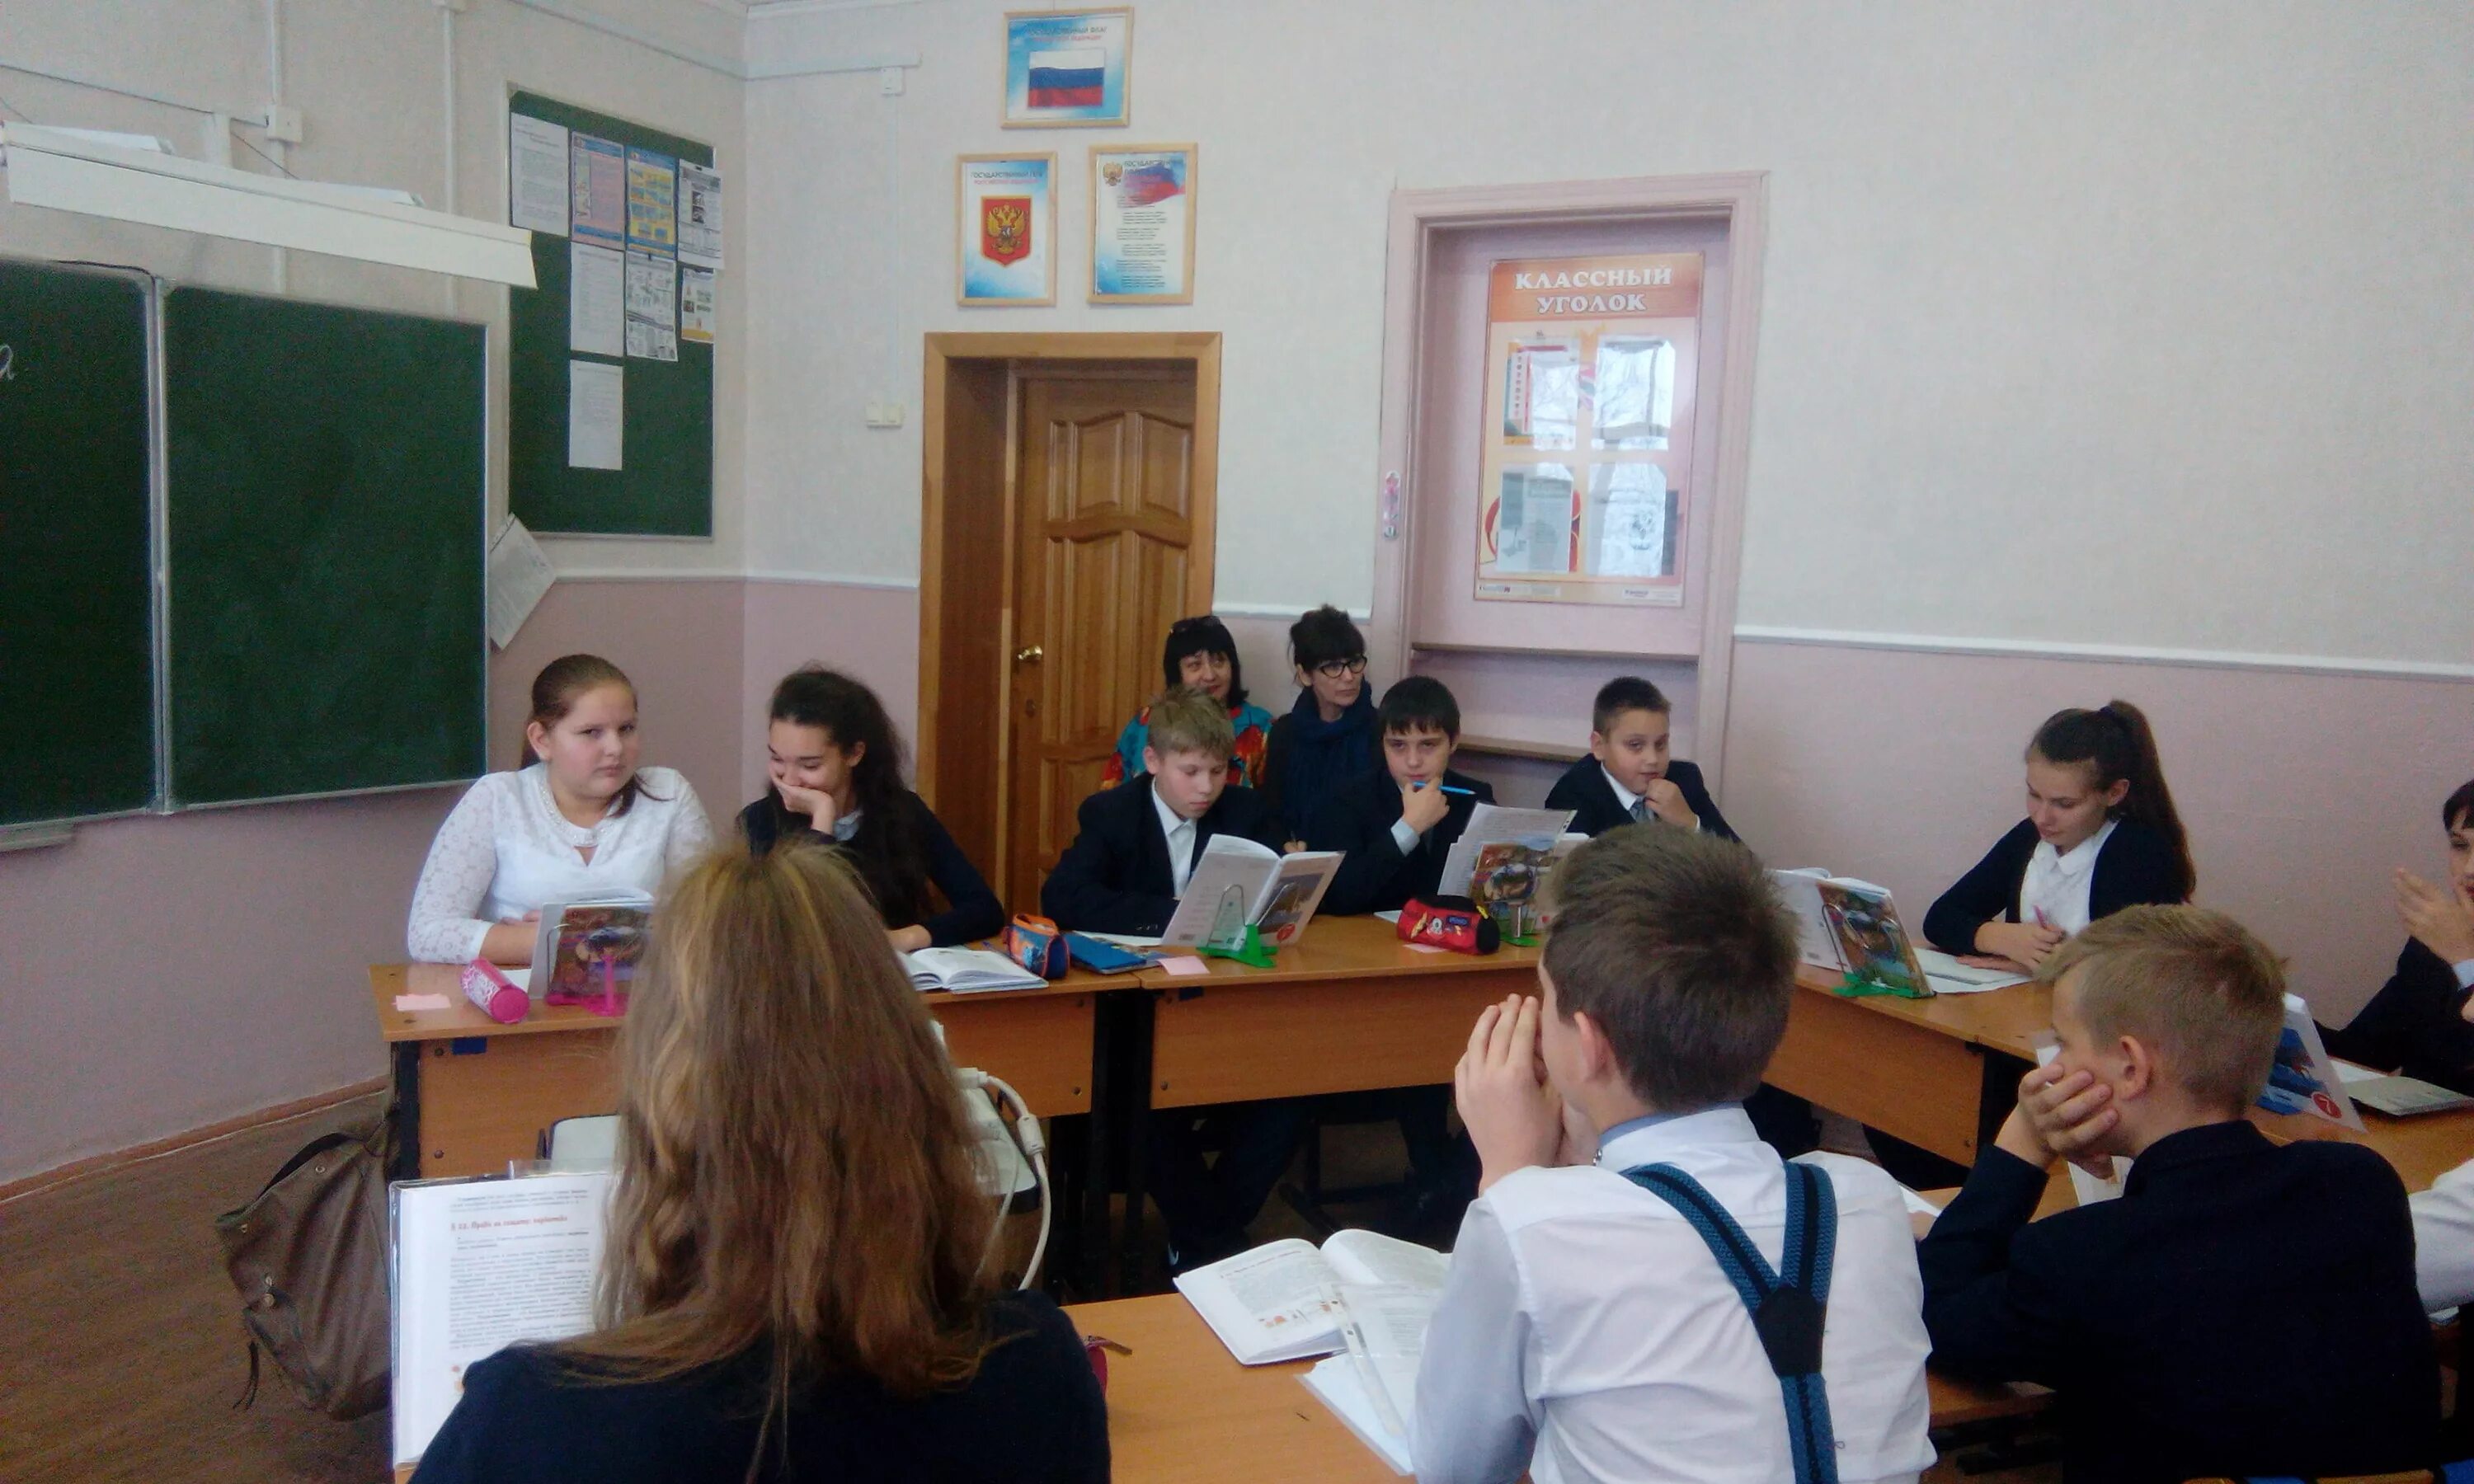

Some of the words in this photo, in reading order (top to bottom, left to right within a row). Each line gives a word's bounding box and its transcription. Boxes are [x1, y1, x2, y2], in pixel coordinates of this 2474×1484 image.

[1515, 264, 1673, 289] КЛАССНЫЙ
[1537, 293, 1648, 313] УГОЛОК
[2319, 1096, 2332, 1115] 7
